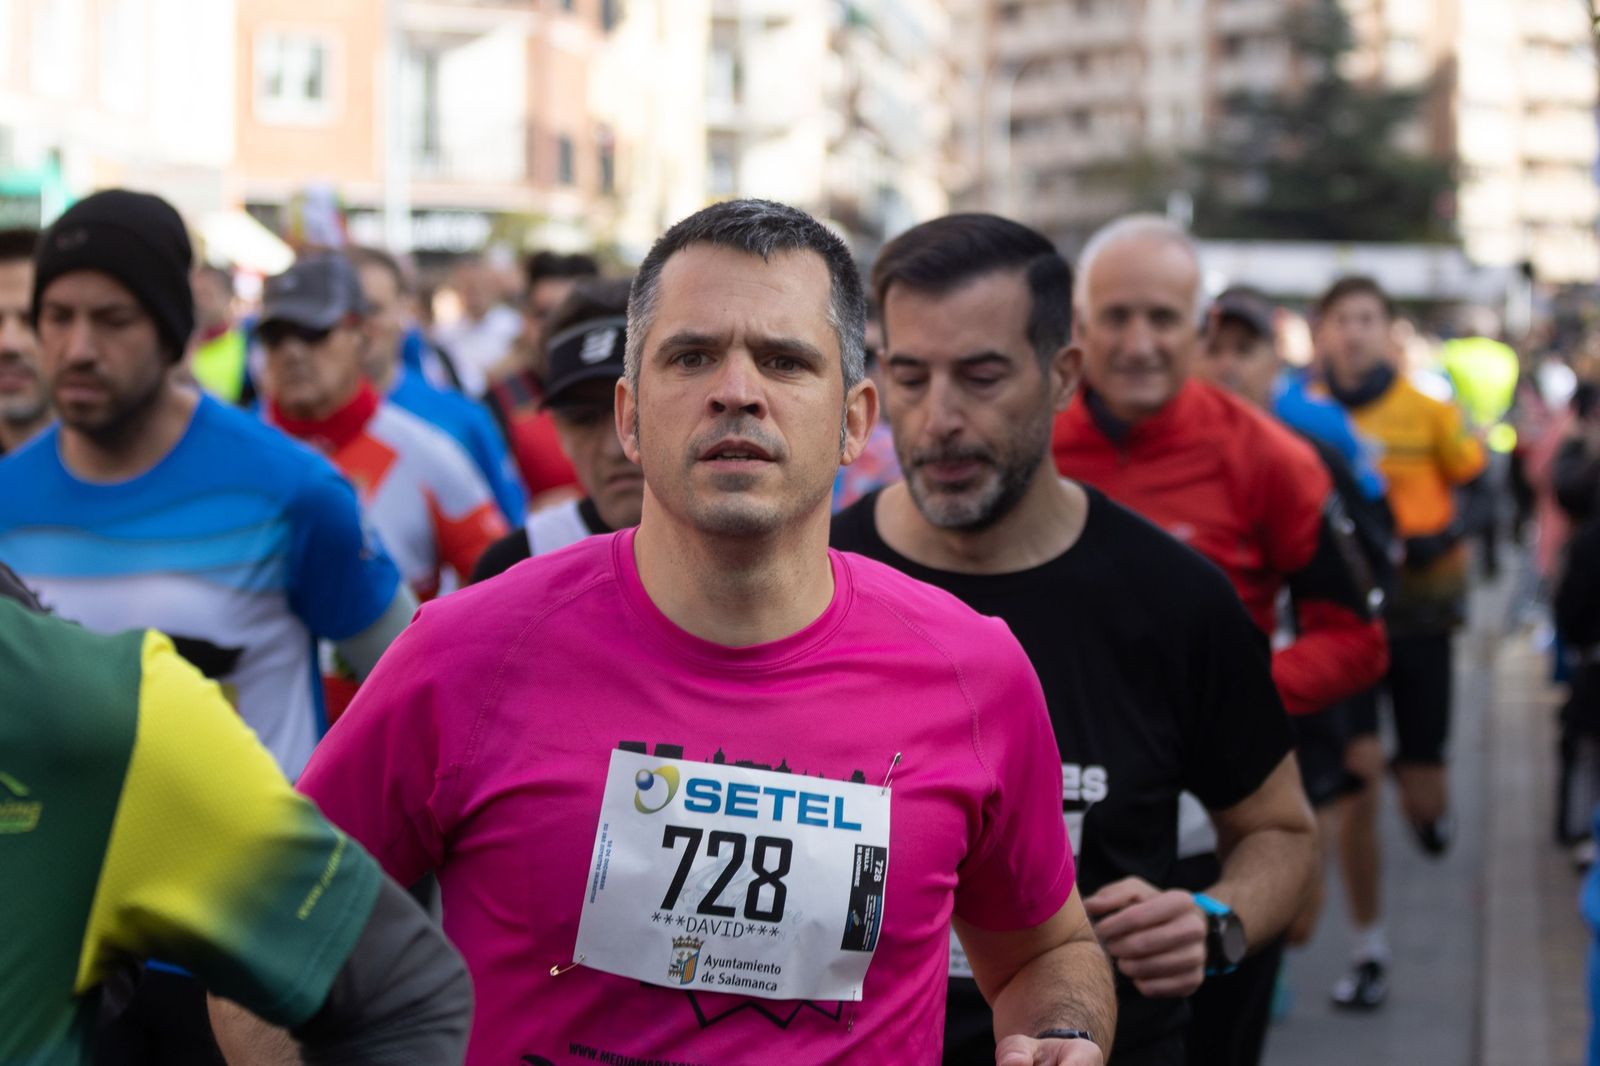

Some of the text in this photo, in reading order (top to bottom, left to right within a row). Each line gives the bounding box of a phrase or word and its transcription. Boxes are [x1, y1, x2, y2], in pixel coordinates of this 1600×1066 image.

[684, 777, 863, 832] SETEL
[660, 824, 794, 924] 728
[873, 859, 884, 882] 728
[703, 954, 783, 976] Ayuntamiento
[700, 973, 778, 992] de Salamanca
